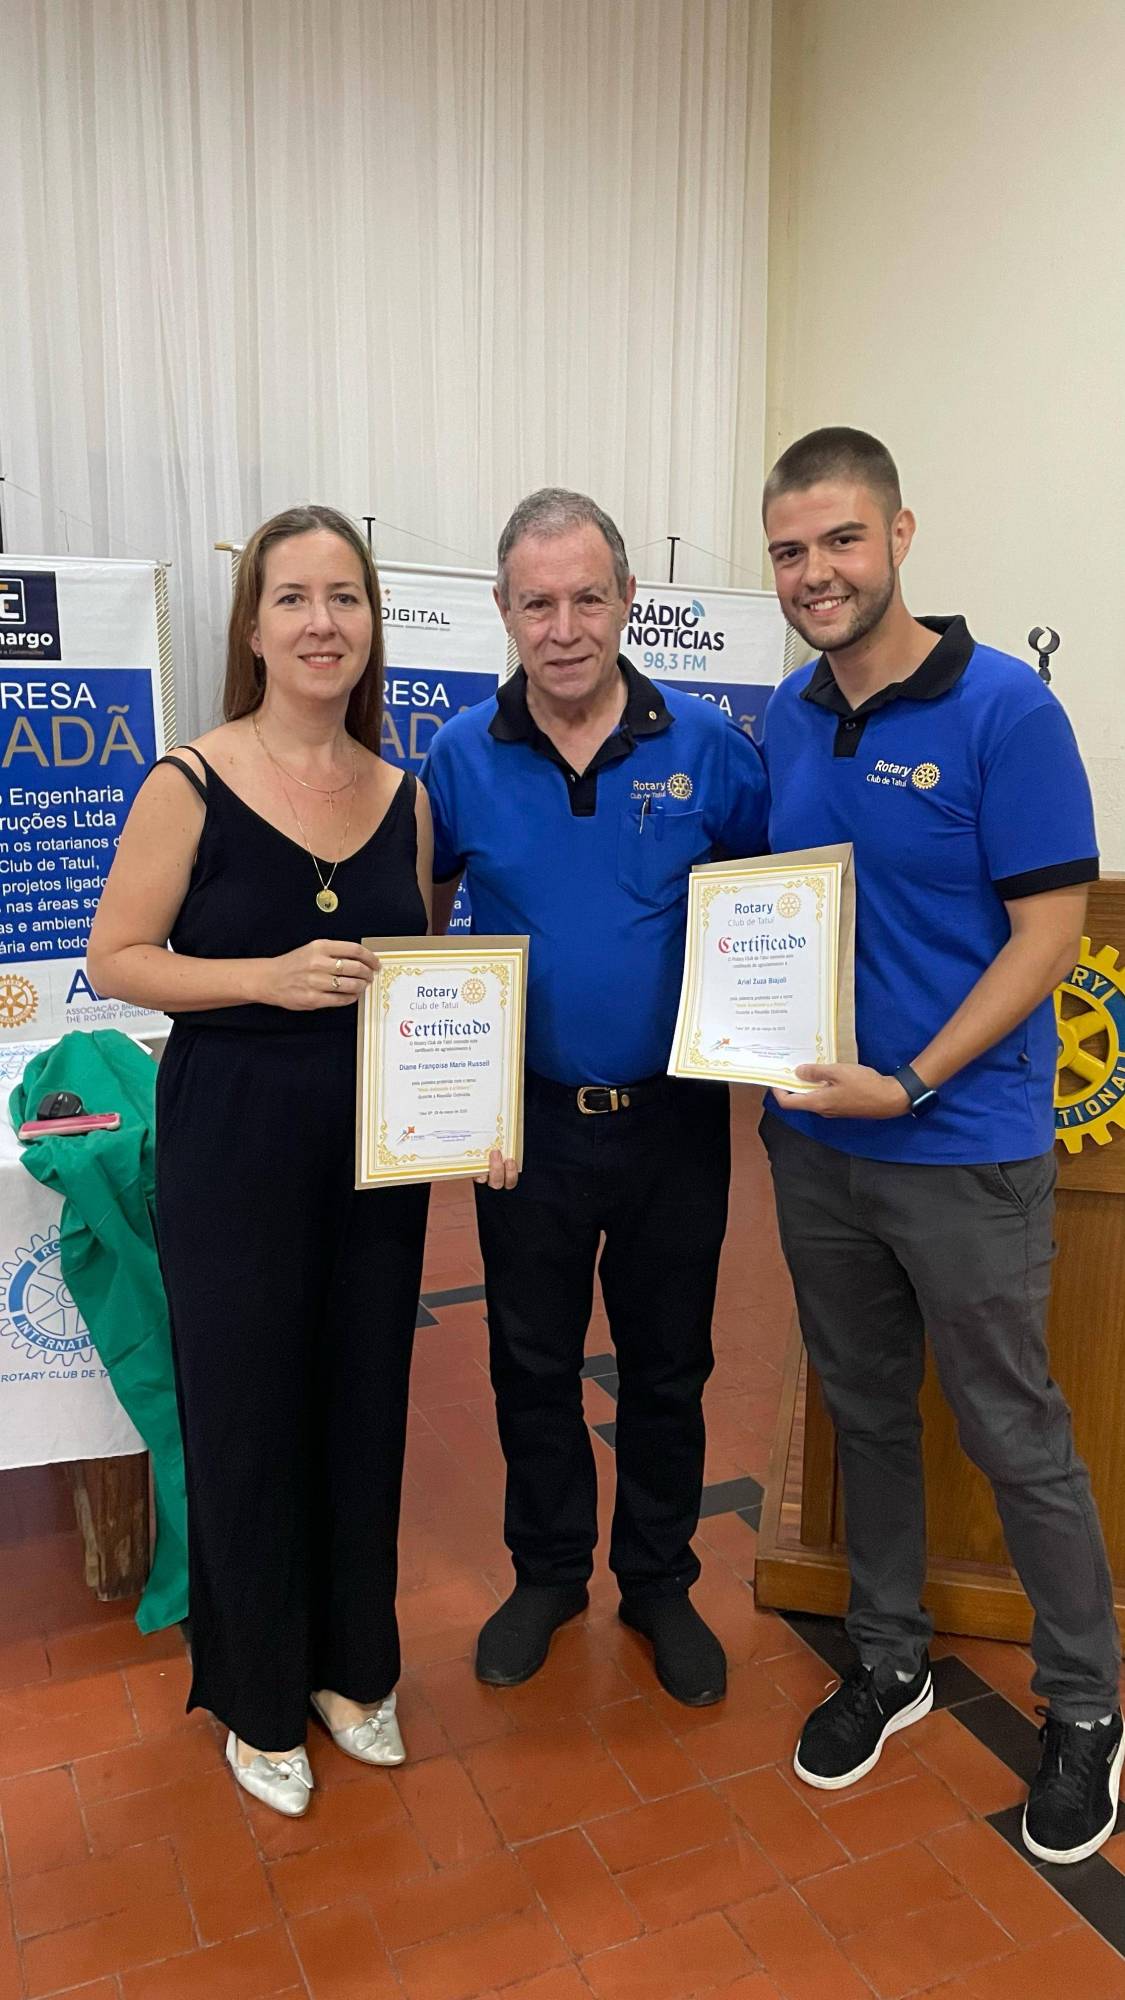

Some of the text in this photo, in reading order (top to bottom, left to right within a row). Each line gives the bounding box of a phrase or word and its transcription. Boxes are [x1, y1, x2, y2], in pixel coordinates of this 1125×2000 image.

[627, 626, 725, 651] NOTÍCIAS
[643, 651, 707, 671] 98,3 FM
[875, 760, 912, 777] Rotary
[633, 780, 666, 791] Rotary
[866, 773, 880, 784] Club
[881, 777, 890, 785] de
[9, 785, 124, 809] Engenharia
[73, 809, 117, 828] Ltda
[13, 841, 32, 852] os
[36, 837, 109, 851] rotarianos
[0, 859, 33, 873] Club
[37, 858, 56, 871] de
[2, 879, 62, 897] projetos
[6, 901, 33, 913] nas
[37, 898, 79, 911] áreas
[734, 903, 774, 915] Rotary
[18, 922, 28, 933] e
[727, 919, 745, 927] Club
[746, 919, 756, 927] de
[30, 940, 53, 952] em
[718, 934, 806, 954] Certificado
[417, 986, 458, 999] Rotary
[66, 1003, 119, 1015] ASSOCIAÇÃO
[409, 1002, 428, 1010] Club
[429, 1001, 440, 1010] de
[66, 1015, 80, 1024] THE
[84, 1011, 117, 1022] ROTARY
[400, 1019, 491, 1039] Certificado
[1, 1371, 45, 1382] ROTARY
[48, 1370, 78, 1379] CLUB
[81, 1369, 96, 1378] DE
